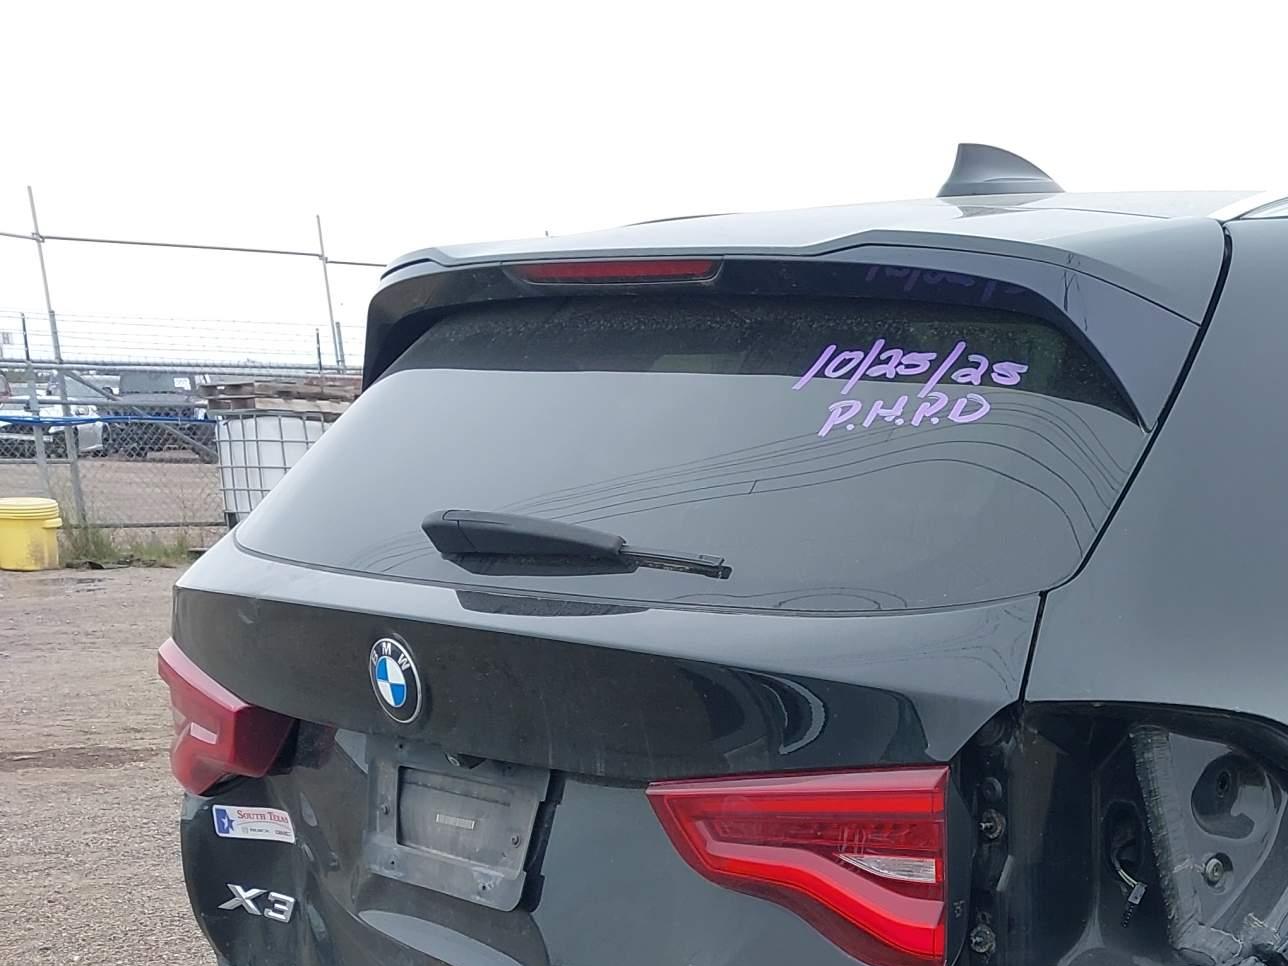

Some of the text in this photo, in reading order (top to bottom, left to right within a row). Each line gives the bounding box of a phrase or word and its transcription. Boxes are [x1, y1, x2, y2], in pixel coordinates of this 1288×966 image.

[792, 338, 1029, 398] 10/25/25
[371, 641, 411, 671] BMW
[217, 883, 295, 924] X3
